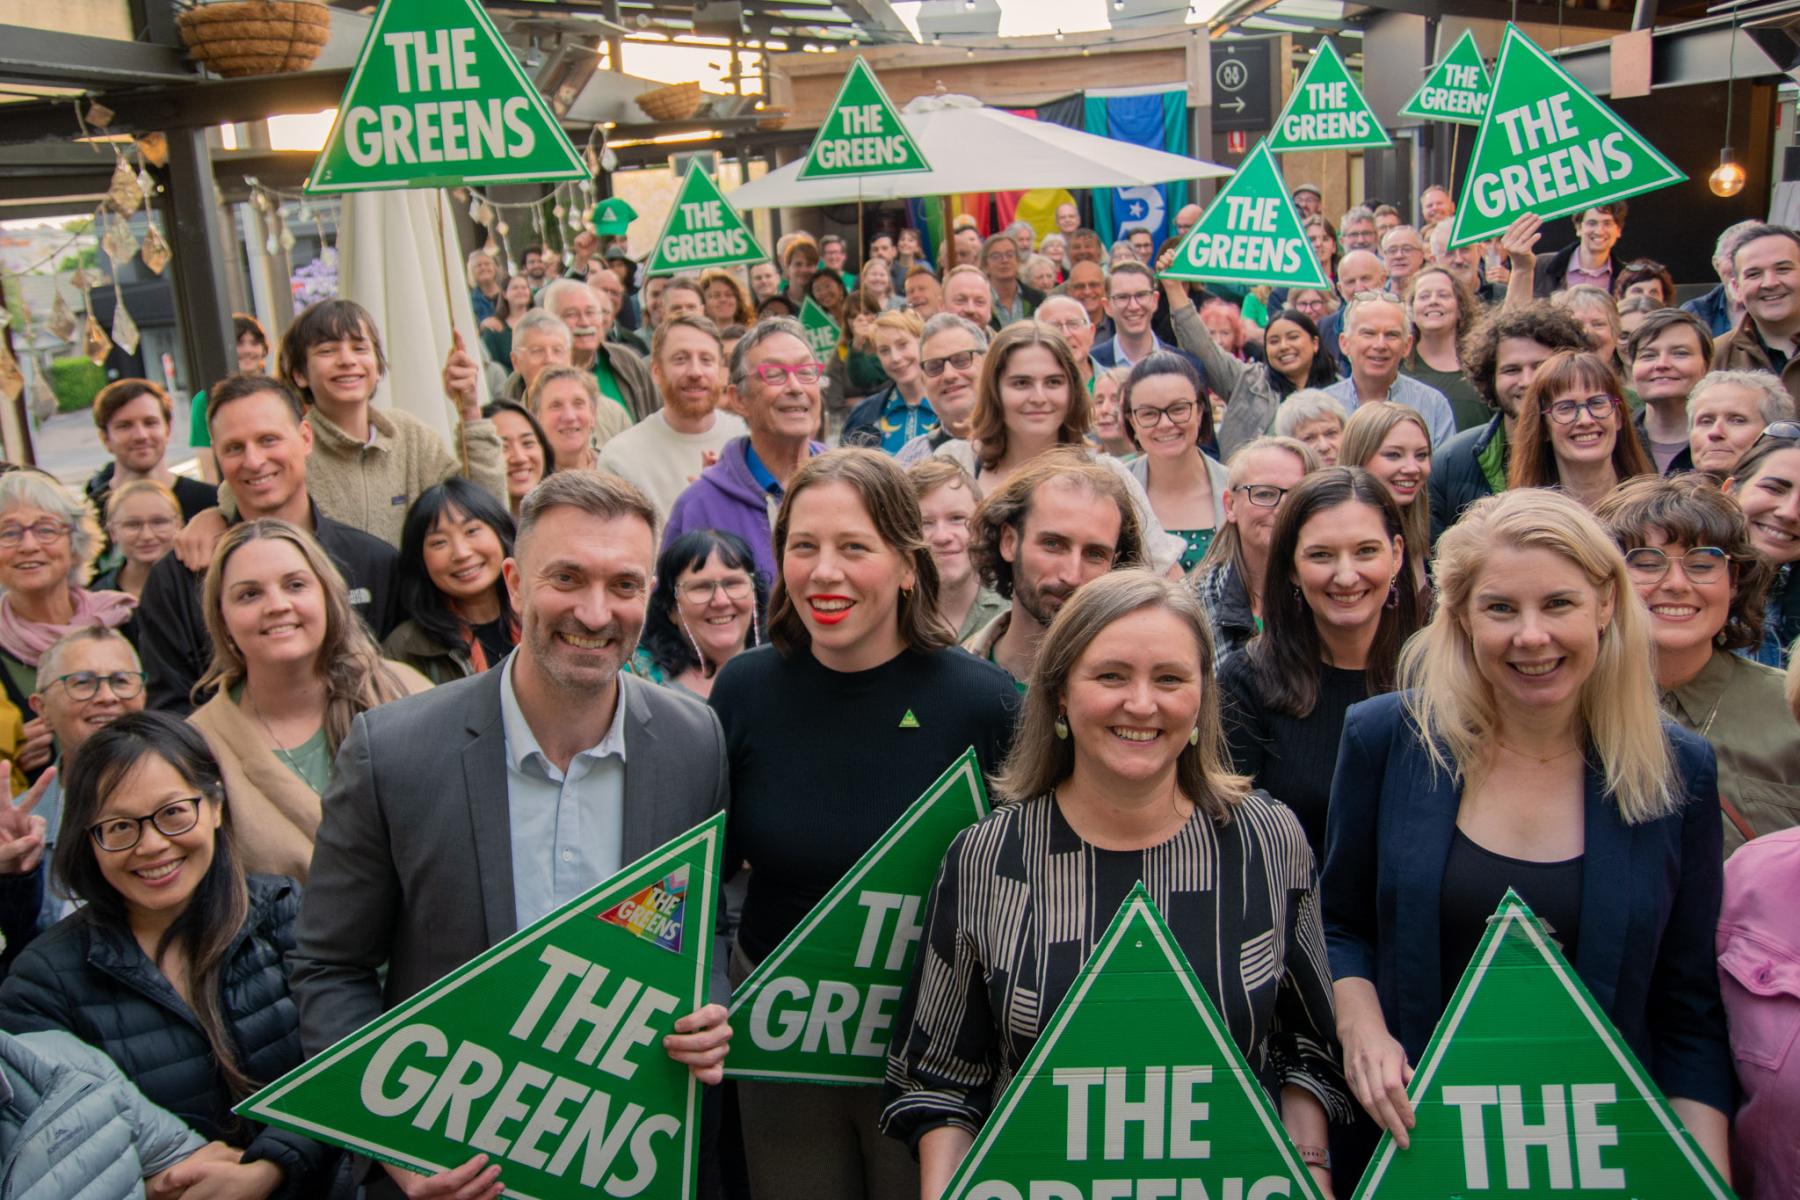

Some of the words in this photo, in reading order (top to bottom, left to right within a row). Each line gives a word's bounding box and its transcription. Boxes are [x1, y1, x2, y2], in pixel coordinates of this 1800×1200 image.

[384, 27, 480, 93] THE
[1444, 63, 1481, 89] THE
[1305, 82, 1348, 110] THE
[344, 96, 536, 167] GREENS
[838, 104, 883, 134] THE
[1283, 111, 1370, 143] GREENS
[1496, 92, 1580, 157] THE
[816, 135, 908, 169] GREENS
[1473, 131, 1633, 218] GREENS
[680, 200, 724, 229] THE
[1226, 196, 1280, 232] THE
[663, 227, 748, 263] GREENS
[1187, 234, 1302, 273] GREENS
[617, 901, 681, 941] GREENS
[647, 887, 681, 916] THE
[854, 890, 924, 971] TH
[510, 944, 681, 1081] THE
[749, 976, 902, 1057] GRE
[360, 1023, 681, 1198] GREENS
[1053, 1065, 1213, 1161] THE
[1442, 1083, 1626, 1190] THE
